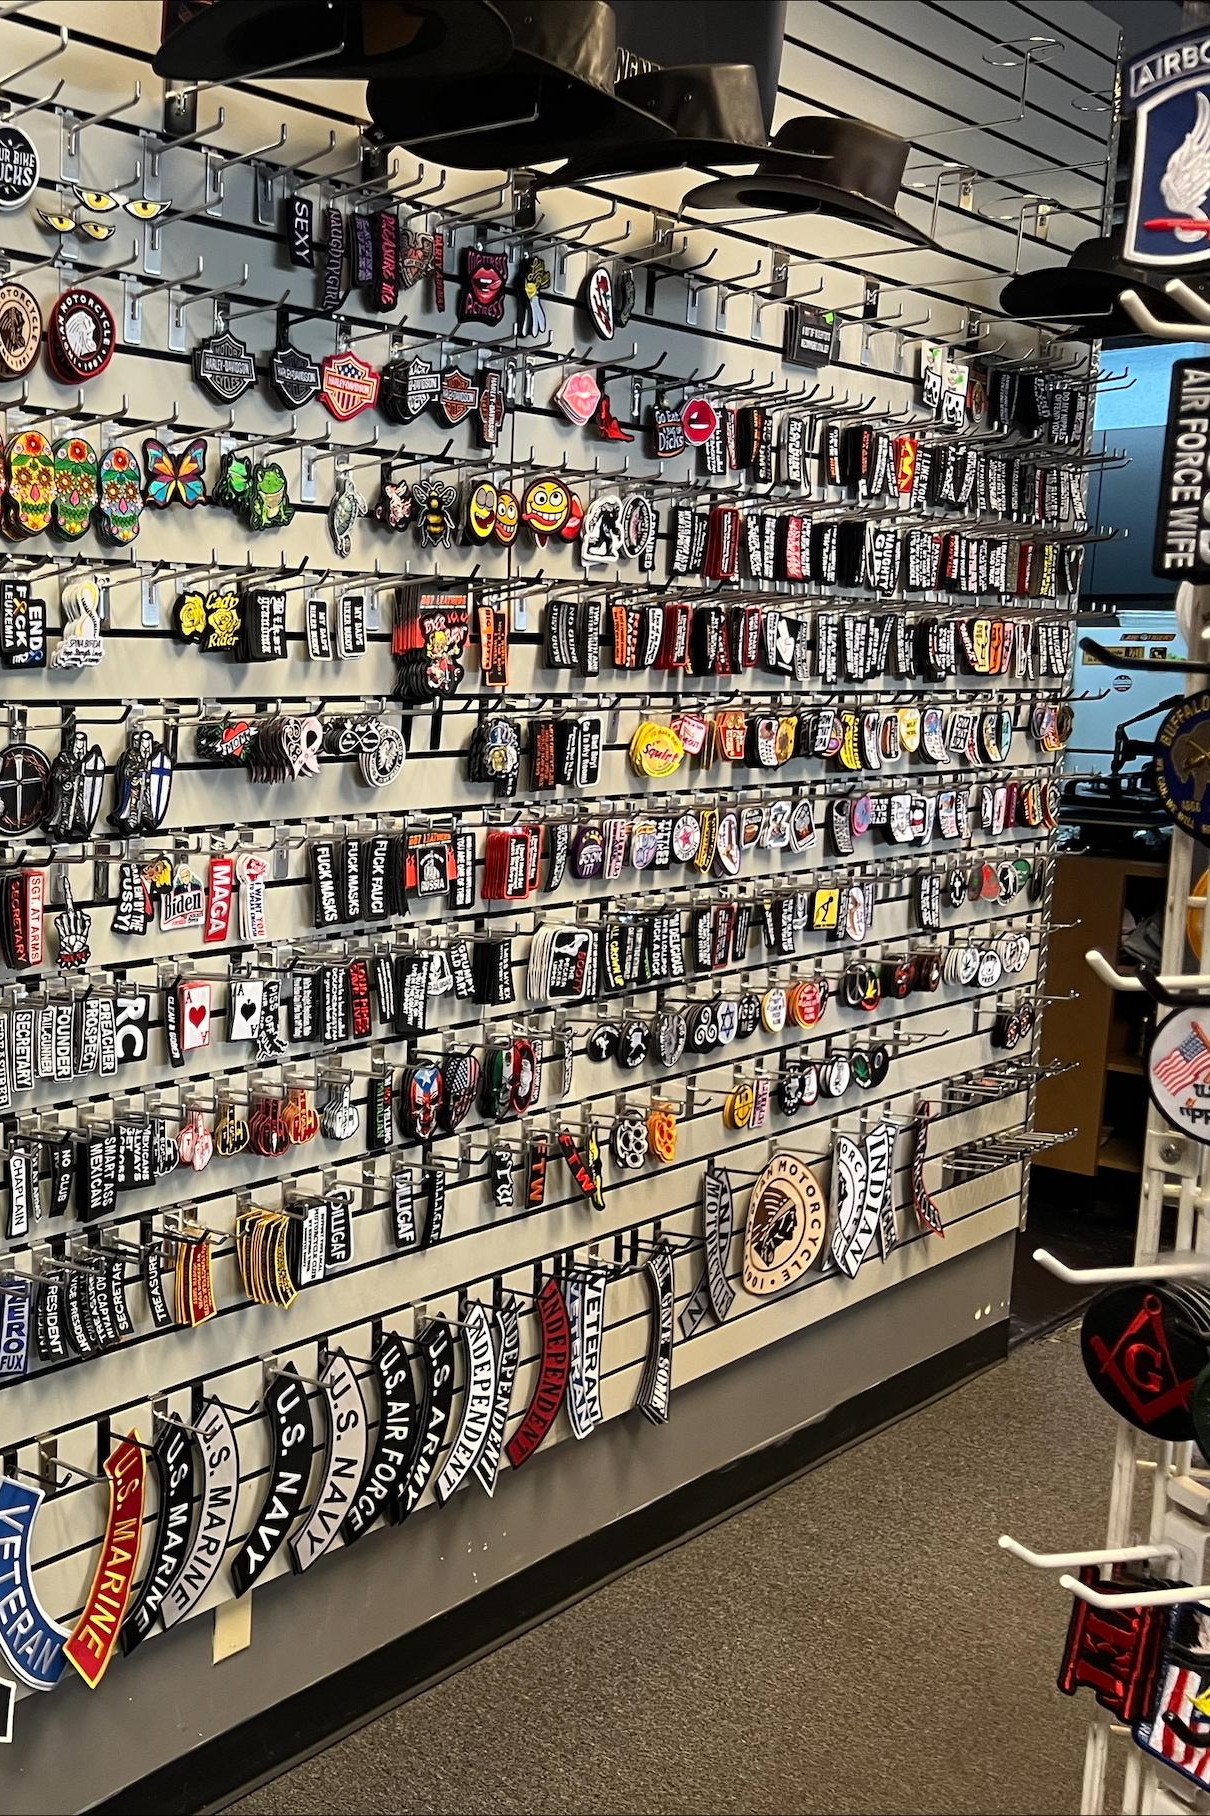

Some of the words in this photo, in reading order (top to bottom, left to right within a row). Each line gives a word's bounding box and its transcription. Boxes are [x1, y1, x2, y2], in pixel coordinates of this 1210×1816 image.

[13, 151, 35, 168] BIKE
[294, 201, 310, 263] SEXY
[205, 356, 251, 375] HARLEY-DAVIDSON
[1180, 368, 1210, 413] AIR
[658, 433, 684, 451] Dicks
[1172, 418, 1209, 502] FORCE
[1164, 506, 1199, 569] WIFE
[4, 585, 15, 648] LEUKEMIA
[206, 592, 239, 609] Lady
[208, 636, 238, 648] Rider
[642, 743, 679, 763] Squirt
[317, 847, 330, 880] FUCK
[347, 841, 358, 873] FUCK
[372, 840, 389, 875] FUCK
[114, 867, 133, 932] PUSSY!
[166, 892, 201, 920] Biden
[209, 866, 231, 935] MAGA
[319, 881, 338, 922] MASKS
[347, 876, 360, 916] MASKS
[370, 877, 385, 914] FAUCI
[14, 1012, 31, 1087] SECRETARY
[55, 1006, 71, 1077] FOUNDER
[101, 1003, 115, 1070] PREACHER
[116, 999, 144, 1058] RC
[13, 1159, 24, 1226] CHAPLAIN
[396, 1172, 414, 1244] DILLIGAF
[1123, 1341, 1162, 1394] G
[275, 1383, 305, 1457] U.S.
[382, 1399, 411, 1443] AIR
[112, 1453, 140, 1512] U.S.
[304, 1456, 360, 1558] NAVY
[347, 1446, 405, 1534] FORCE
[167, 1484, 233, 1612] MARINE
[246, 1470, 302, 1575] NAVY
[77, 1516, 137, 1661] MARINE
